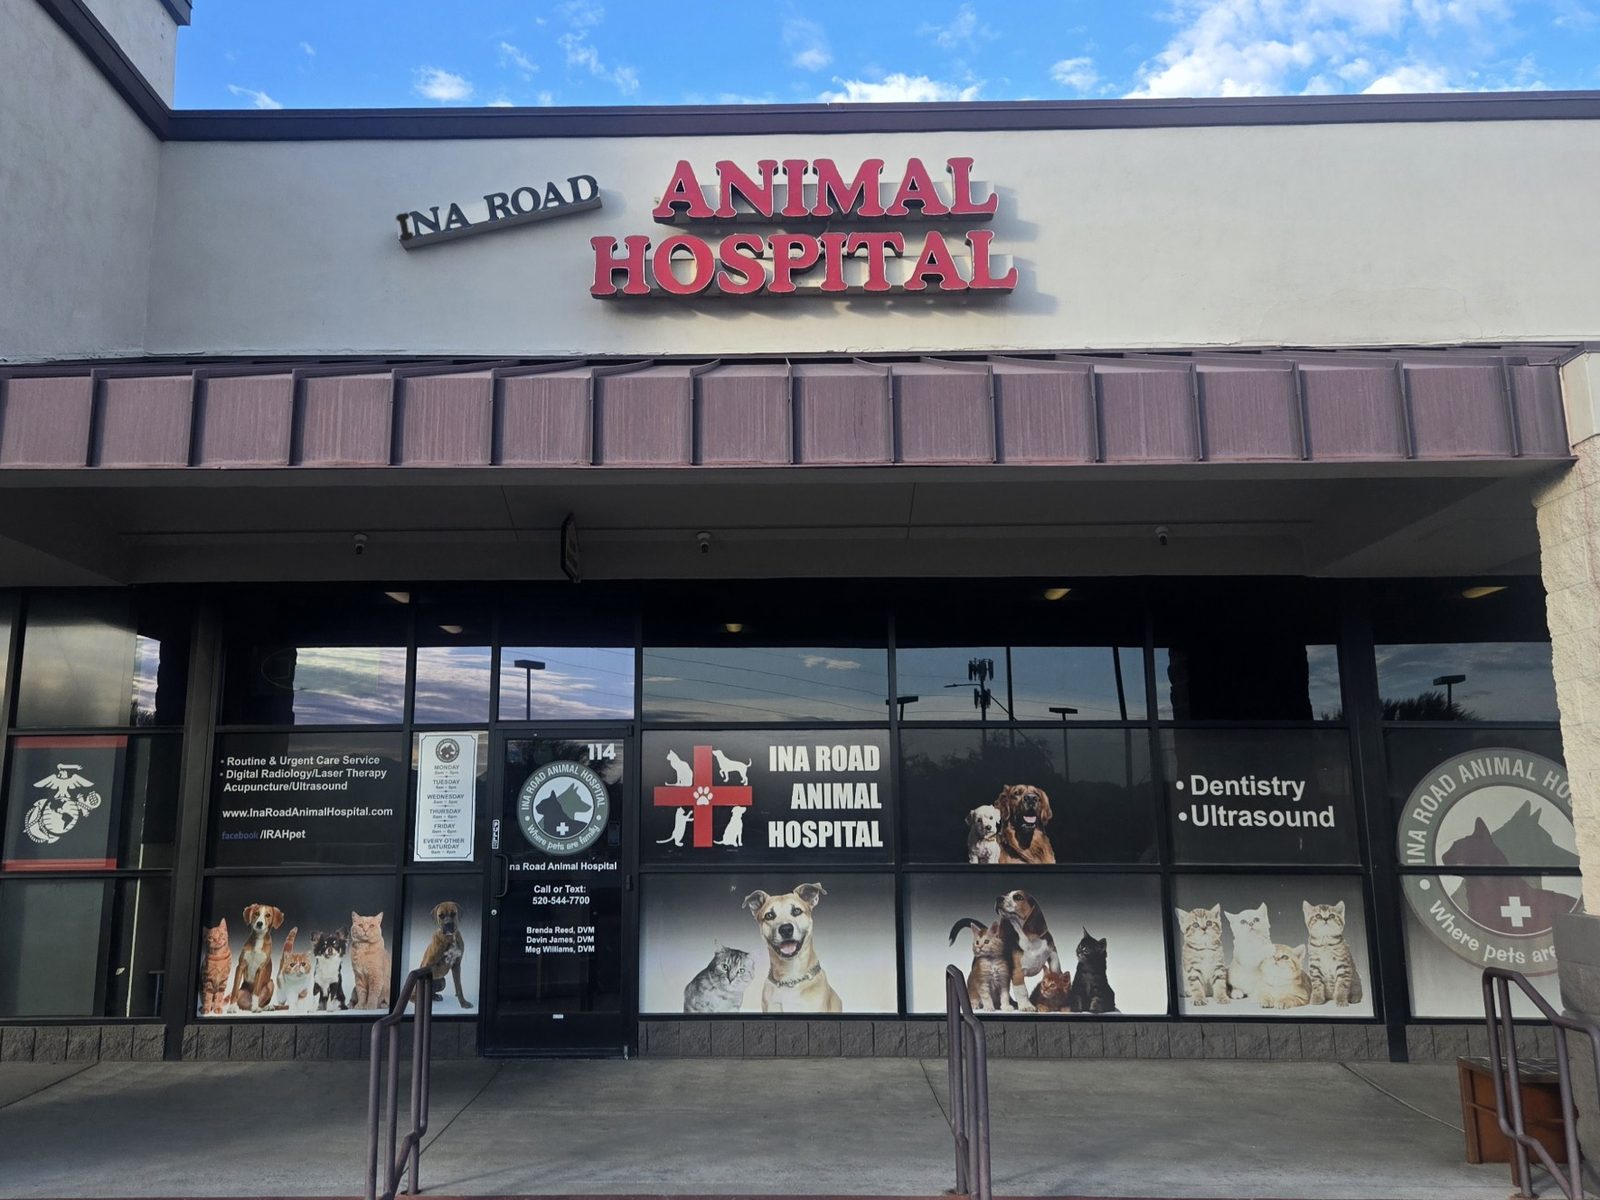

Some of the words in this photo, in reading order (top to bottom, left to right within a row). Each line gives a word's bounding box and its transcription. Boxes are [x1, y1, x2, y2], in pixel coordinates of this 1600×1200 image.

[652, 157, 998, 218] ANIMAL
[396, 203, 473, 240] INA
[483, 175, 599, 221] ROAD
[589, 230, 1018, 295] HOSPITAL
[226, 757, 267, 766] Routine
[268, 757, 277, 766] &
[279, 756, 313, 767] Urgent
[316, 755, 340, 765] Care
[342, 755, 380, 765] Service
[587, 743, 616, 760] 114
[769, 746, 810, 771] INA
[815, 745, 880, 771] ROAD
[226, 769, 258, 780] Digital
[261, 768, 343, 780] Radiology/Laser
[346, 768, 387, 779] Therapy
[547, 764, 579, 776] ANIMAL
[1457, 757, 1537, 784] ANIMAL
[223, 781, 348, 793] Acupuncture/Ultrasound
[526, 772, 546, 794] ROAD
[580, 769, 606, 808] HOSPITAL
[1190, 774, 1305, 800] Dentistry
[521, 794, 532, 810] INA
[790, 783, 882, 809] ANIMAL
[1412, 774, 1457, 825] ROAD
[222, 806, 393, 818] www.InaRoadAnimalHospital.com
[1191, 806, 1335, 827] Ultrasound
[221, 831, 258, 840] facebook
[259, 829, 306, 840] /IRAHpet
[527, 824, 547, 846] Where
[546, 841, 565, 850] pets
[566, 841, 579, 850] are
[578, 825, 600, 845] family
[768, 820, 883, 848] HOSPITAL
[1406, 829, 1428, 864] INA
[522, 862, 546, 870] Road
[547, 862, 579, 870] Animal
[580, 861, 617, 872] Hospital
[533, 884, 551, 894] Call
[564, 884, 587, 893] Text:
[532, 896, 590, 905] 520-544-7700
[526, 926, 553, 934] Brenda
[554, 926, 576, 935] Reed,
[577, 926, 595, 934] DVM
[549, 936, 576, 944] James,
[577, 935, 595, 943] DVM
[1429, 900, 1480, 951] Where
[1483, 944, 1526, 964] pets
[525, 945, 541, 954] Meg
[542, 945, 576, 953] Williams,
[577, 945, 595, 953] DVM
